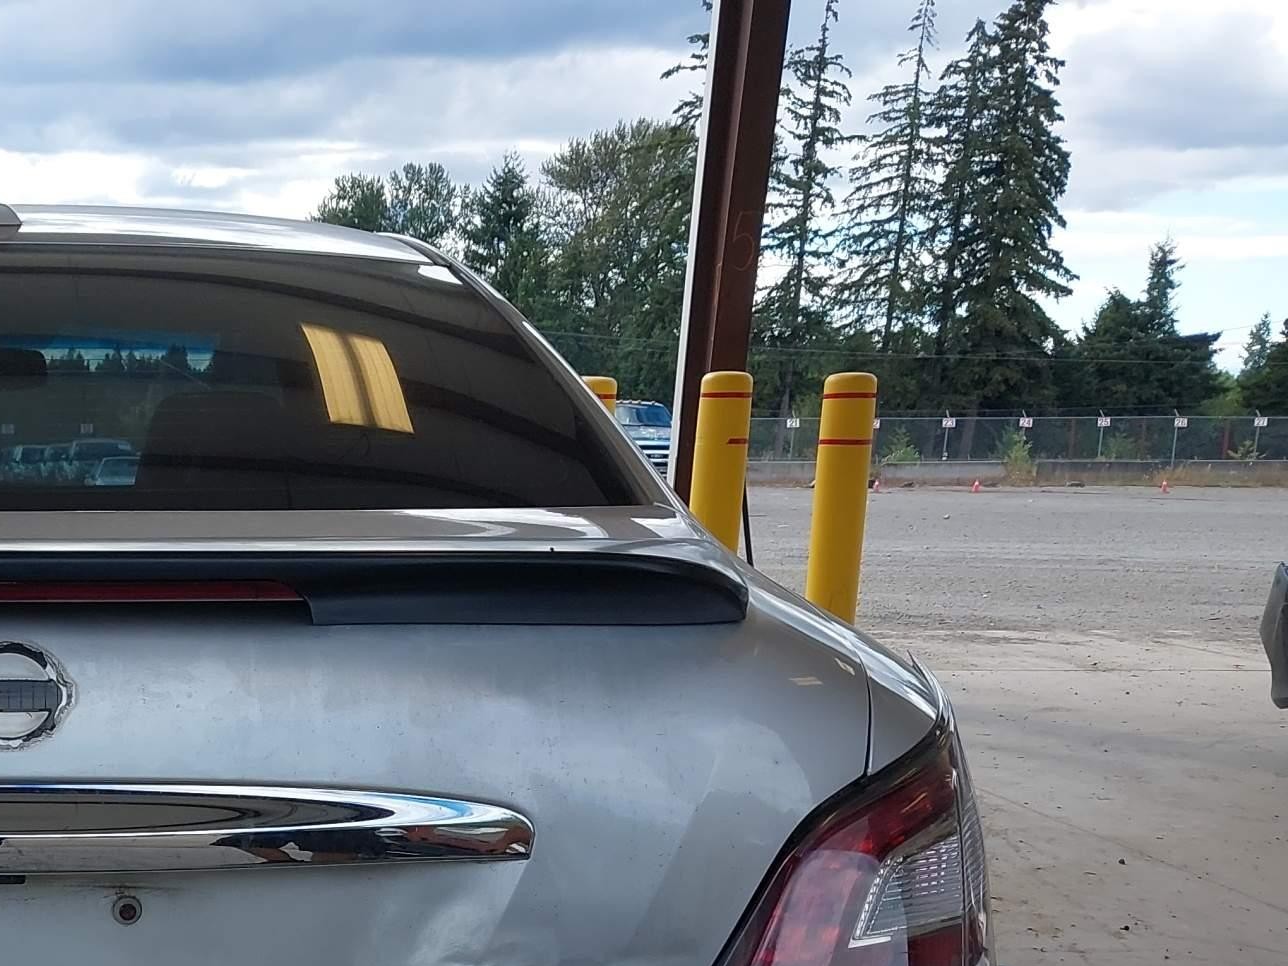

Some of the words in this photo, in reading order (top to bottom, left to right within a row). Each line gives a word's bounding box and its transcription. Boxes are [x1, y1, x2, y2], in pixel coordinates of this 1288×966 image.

[732, 211, 761, 271] 5
[1021, 418, 1032, 427] 24
[1098, 417, 1109, 426] 25
